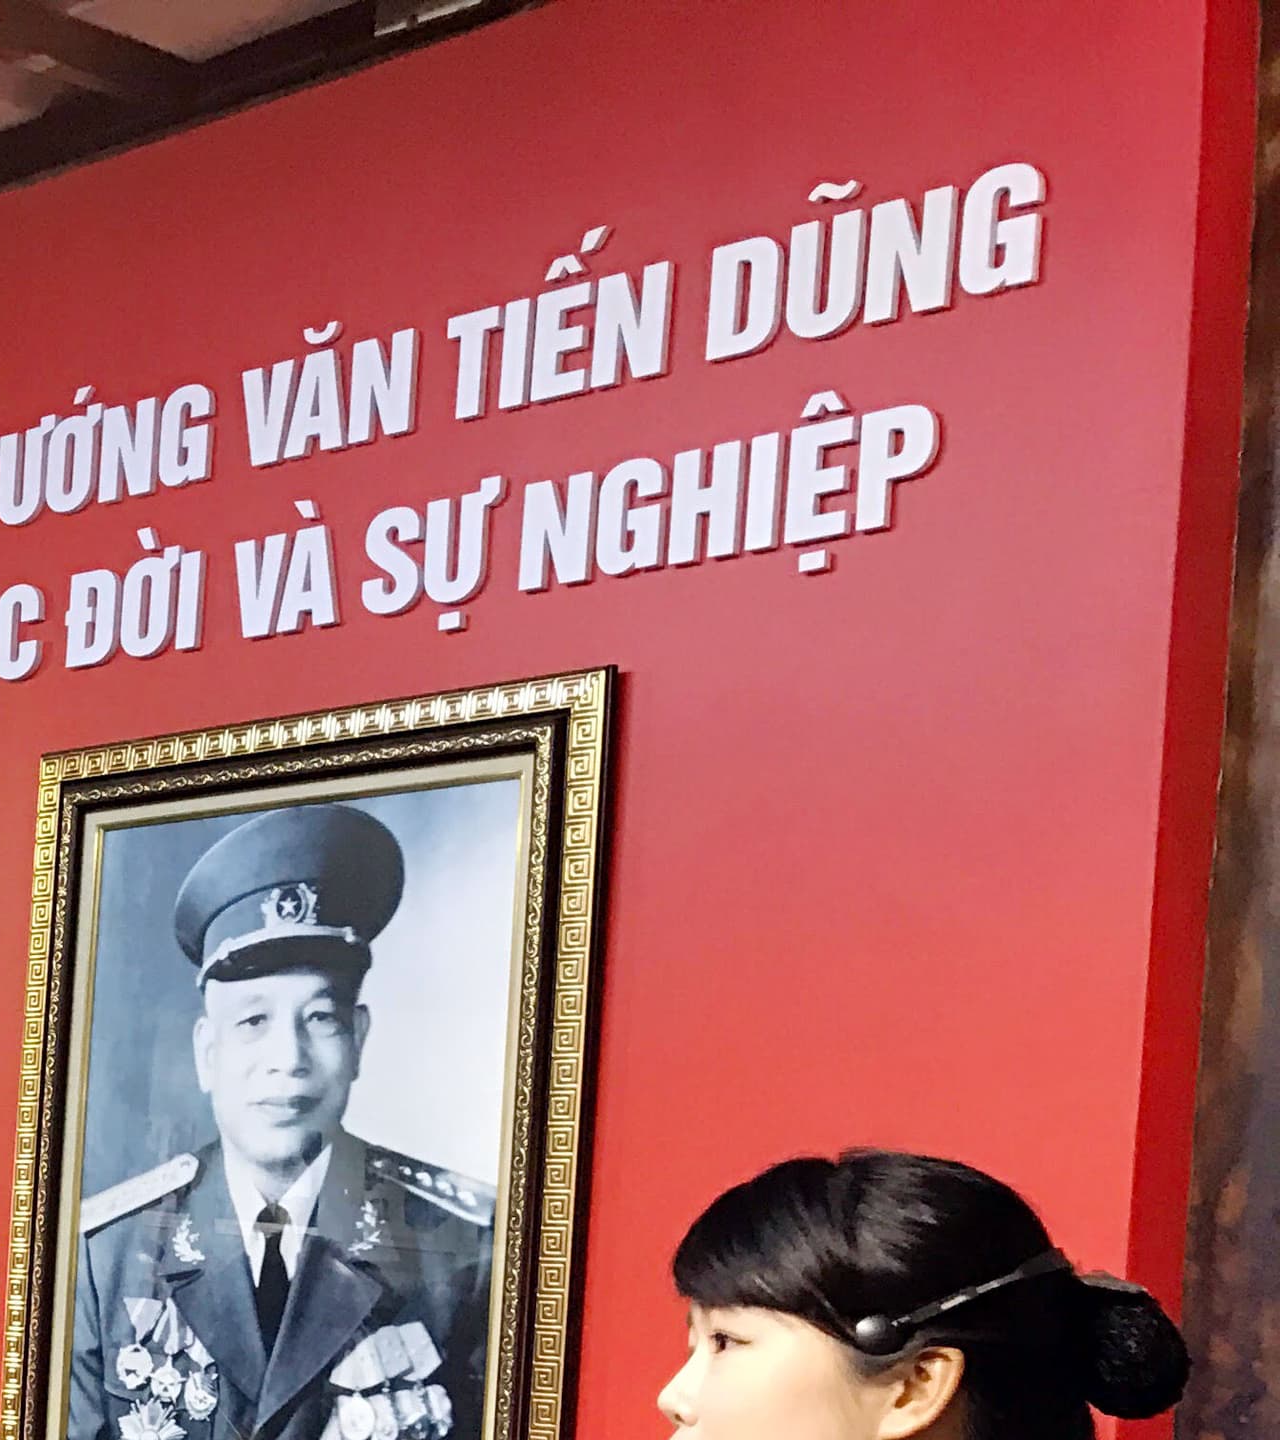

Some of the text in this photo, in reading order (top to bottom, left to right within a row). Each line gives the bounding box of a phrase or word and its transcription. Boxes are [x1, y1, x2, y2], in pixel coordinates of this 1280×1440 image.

[242, 319, 418, 468] VĂN
[446, 225, 673, 421] TIẾN
[704, 162, 1047, 362] DŨNG
[65, 525, 207, 669] ĐỜI
[234, 499, 338, 640] VÀ
[362, 475, 506, 632] SỰ
[517, 390, 941, 593] NGHIỆP
